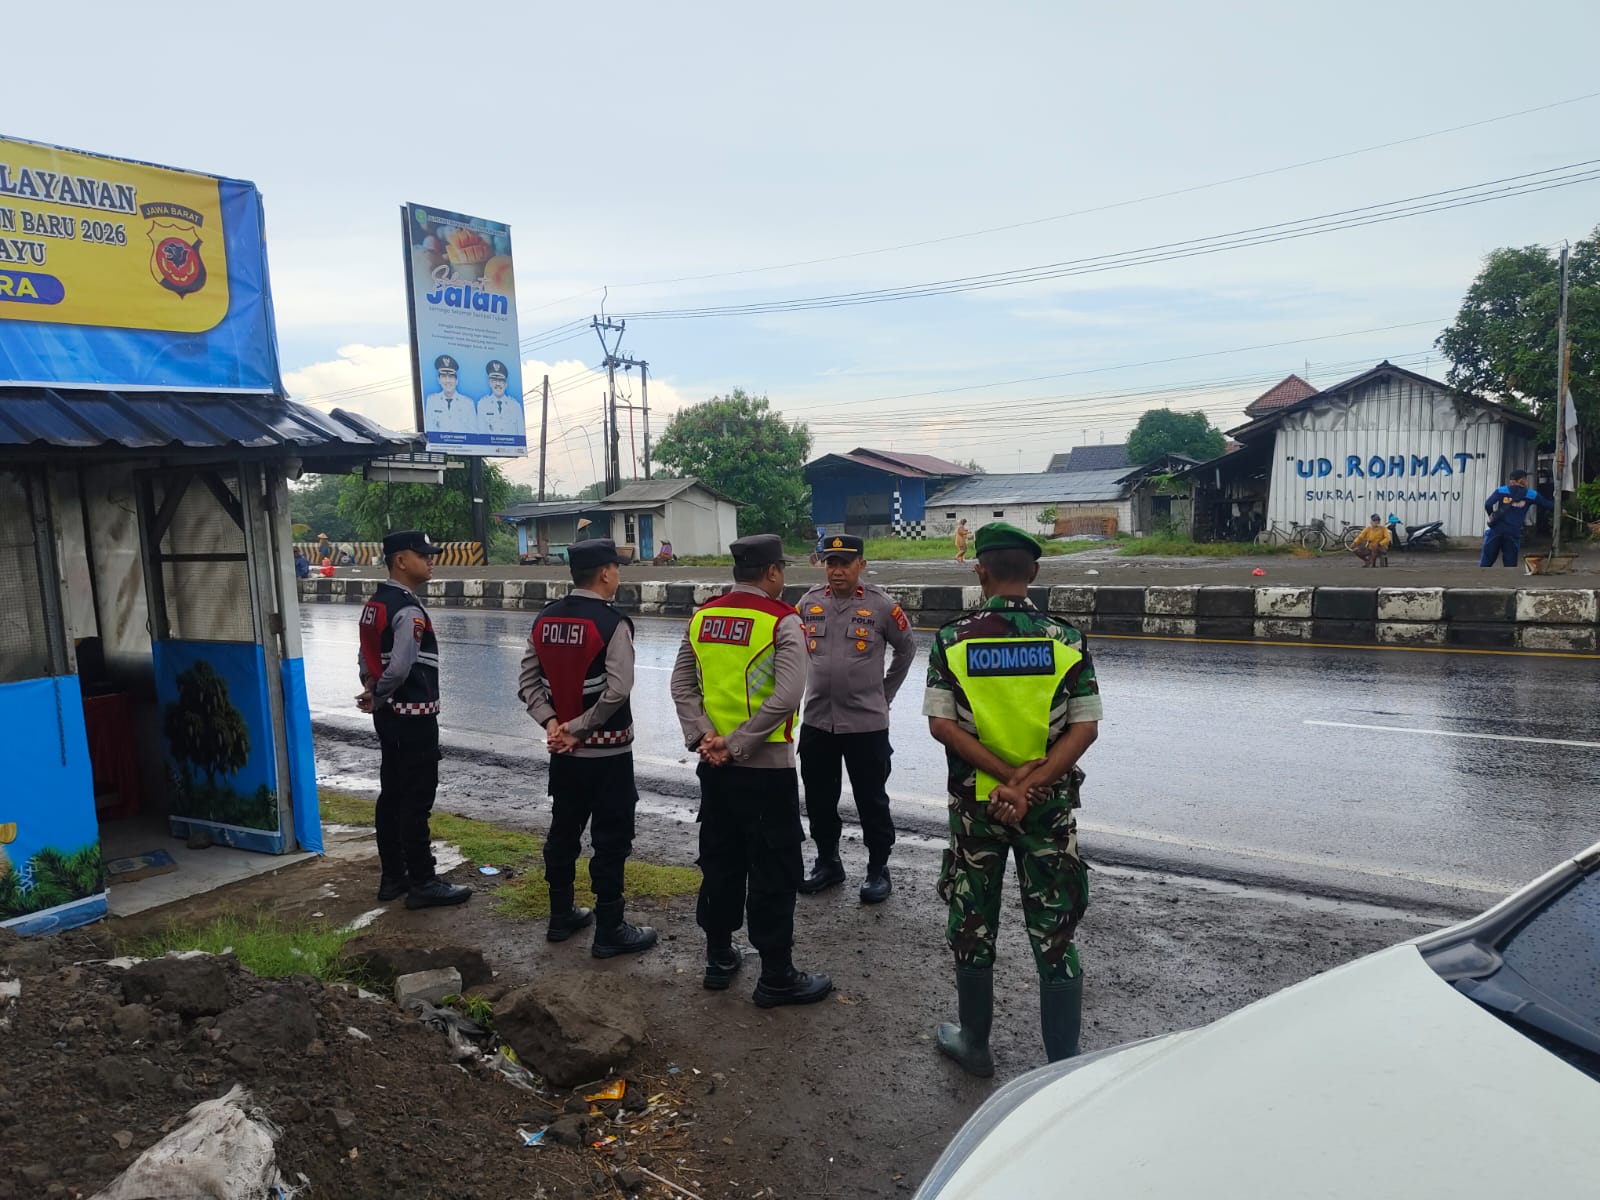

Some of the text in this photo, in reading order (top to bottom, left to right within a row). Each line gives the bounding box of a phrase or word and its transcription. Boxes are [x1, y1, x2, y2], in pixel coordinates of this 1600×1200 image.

[146, 206, 199, 222] JAWA BARAT
[20, 211, 75, 238] BARU
[81, 219, 126, 244] 2026
[701, 619, 749, 642] POLISI
[851, 617, 875, 626] POLRI
[542, 624, 585, 645] POLISI
